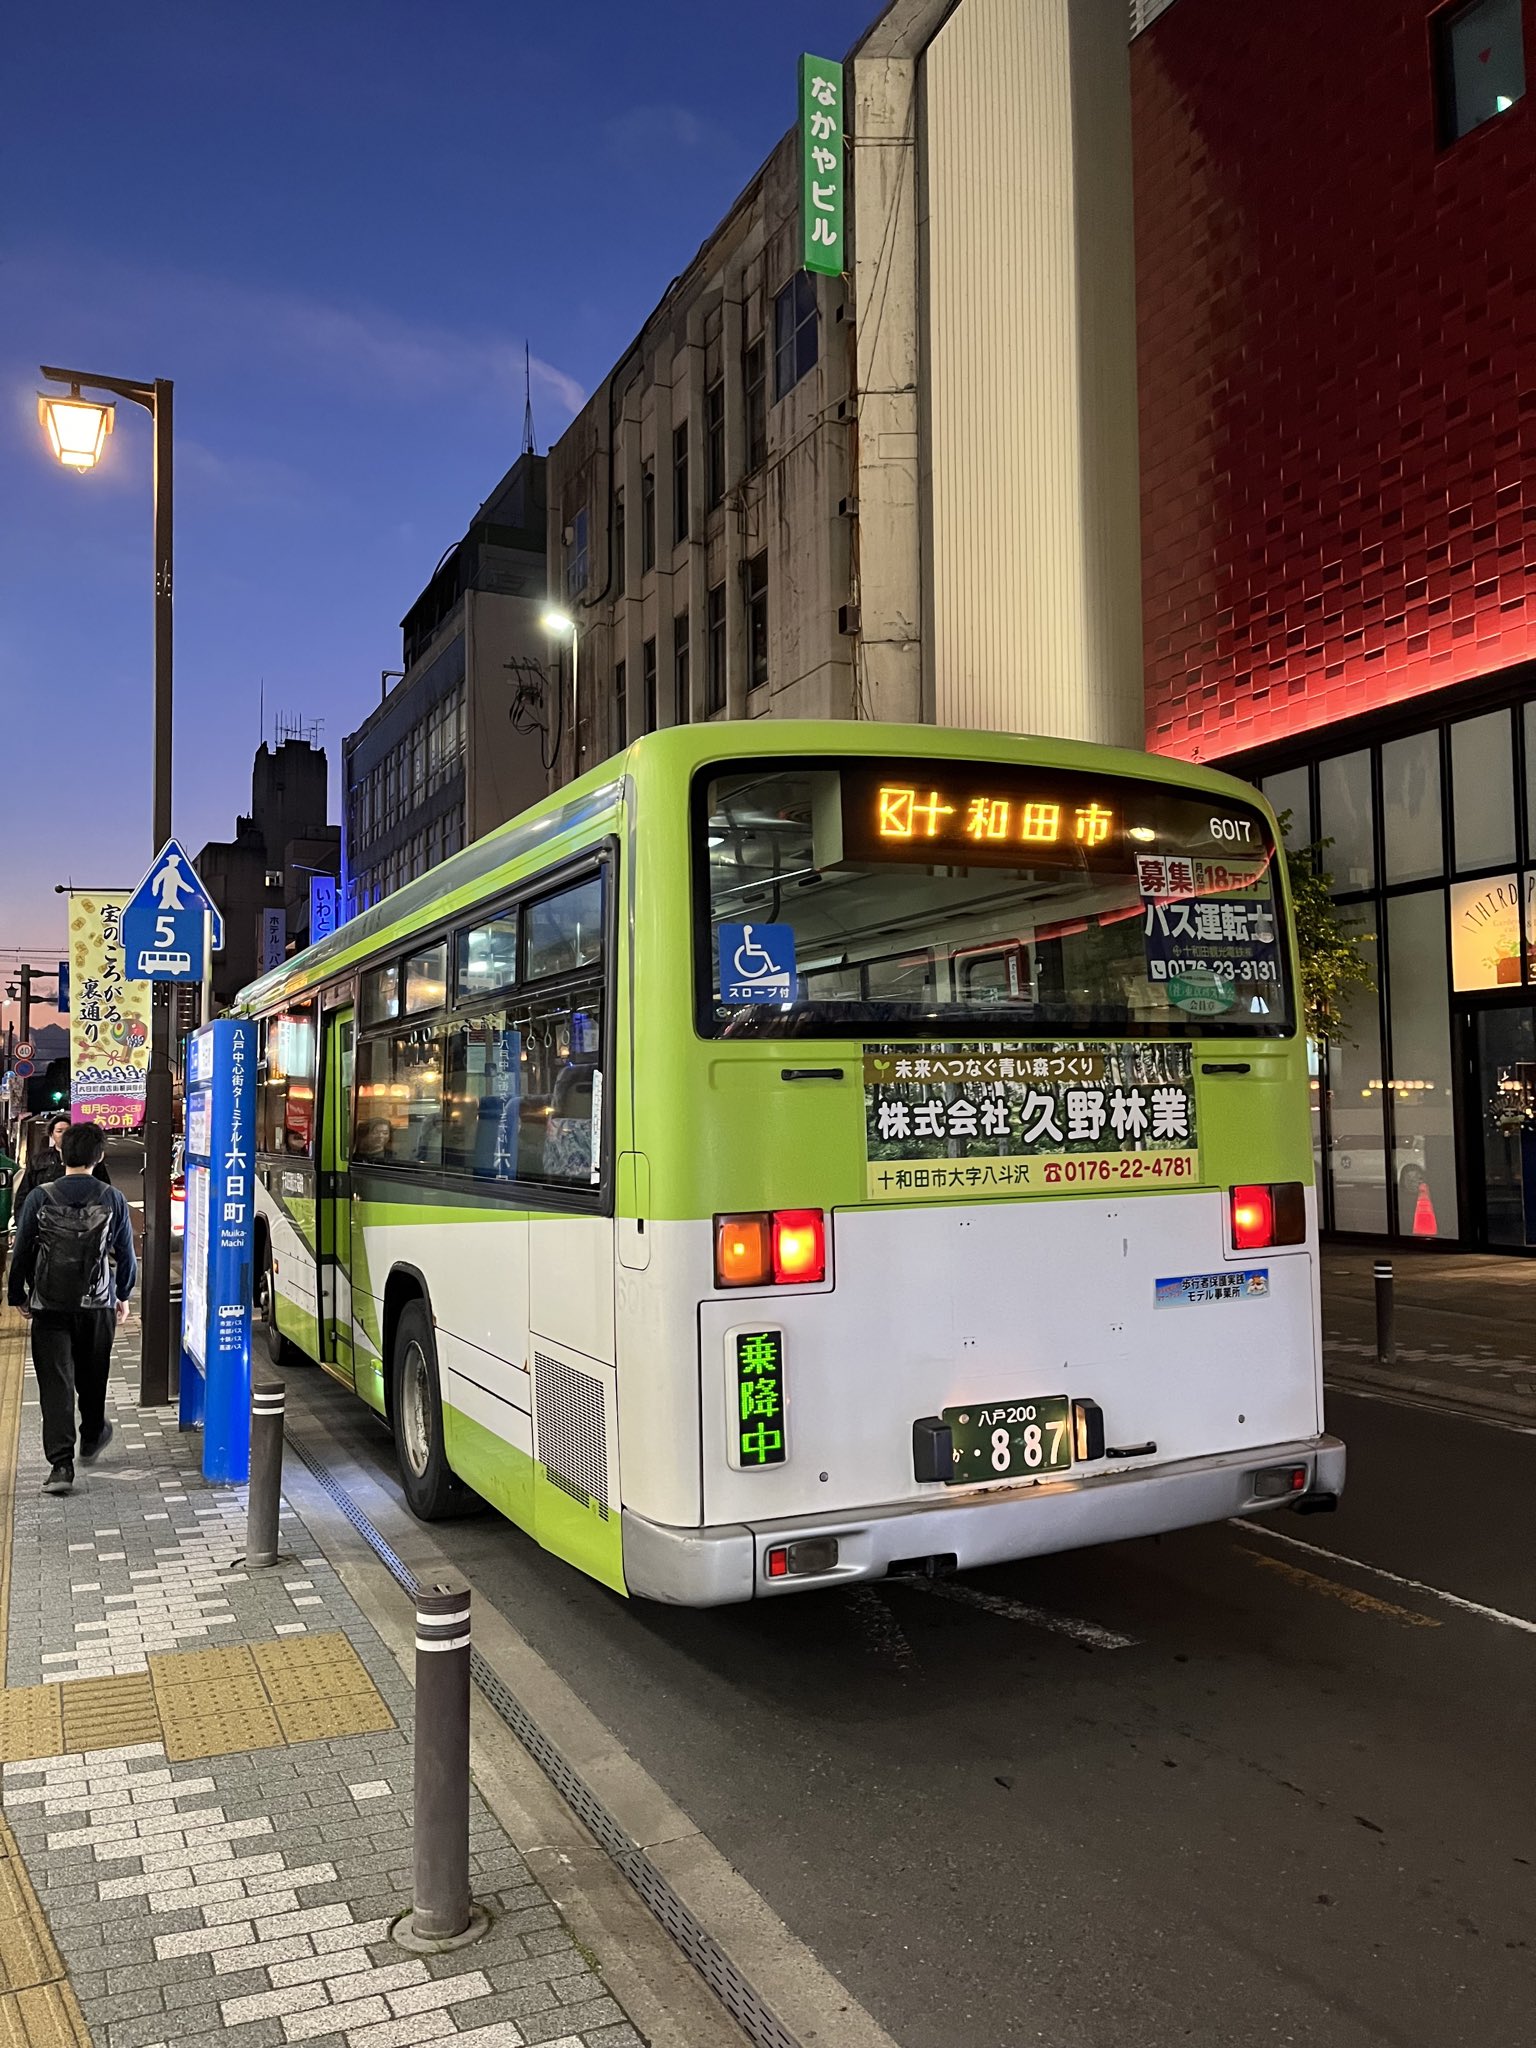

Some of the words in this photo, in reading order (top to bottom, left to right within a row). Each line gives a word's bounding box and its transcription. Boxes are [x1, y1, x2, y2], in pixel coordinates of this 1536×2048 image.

[811, 76, 837, 246] なかやビル
[913, 791, 1113, 846] 十和田市
[1210, 817, 1251, 843] 6017
[1139, 860, 1194, 894] 募集
[1465, 883, 1518, 927] THIRD
[154, 916, 176, 948] 5
[269, 916, 280, 944] ホテル
[1144, 903, 1274, 942] バス運転士
[100, 903, 122, 1023] 宝のころがる
[729, 987, 790, 998] スロープ付
[79, 979, 102, 1043] 裏通り
[231, 1029, 244, 1142] 八戸中心街ターミナル
[894, 1057, 1094, 1080] 未来へつなぐ青い森づくり
[877, 1098, 1012, 1141] 株式会社
[1021, 1086, 1189, 1144] 久野林業
[223, 1149, 247, 1223] 六日町
[877, 1164, 1031, 1191] 十和田市大字八斗沢
[1065, 1156, 1193, 1182] 0176-22-4781
[221, 1229, 247, 1238] Muika-
[221, 1238, 244, 1247] Machi
[1182, 1273, 1245, 1290] 歩行者保護実践
[1188, 1286, 1241, 1302] モデル事業所
[740, 1333, 781, 1463] 乗降中
[978, 1405, 1037, 1427] 八戸200
